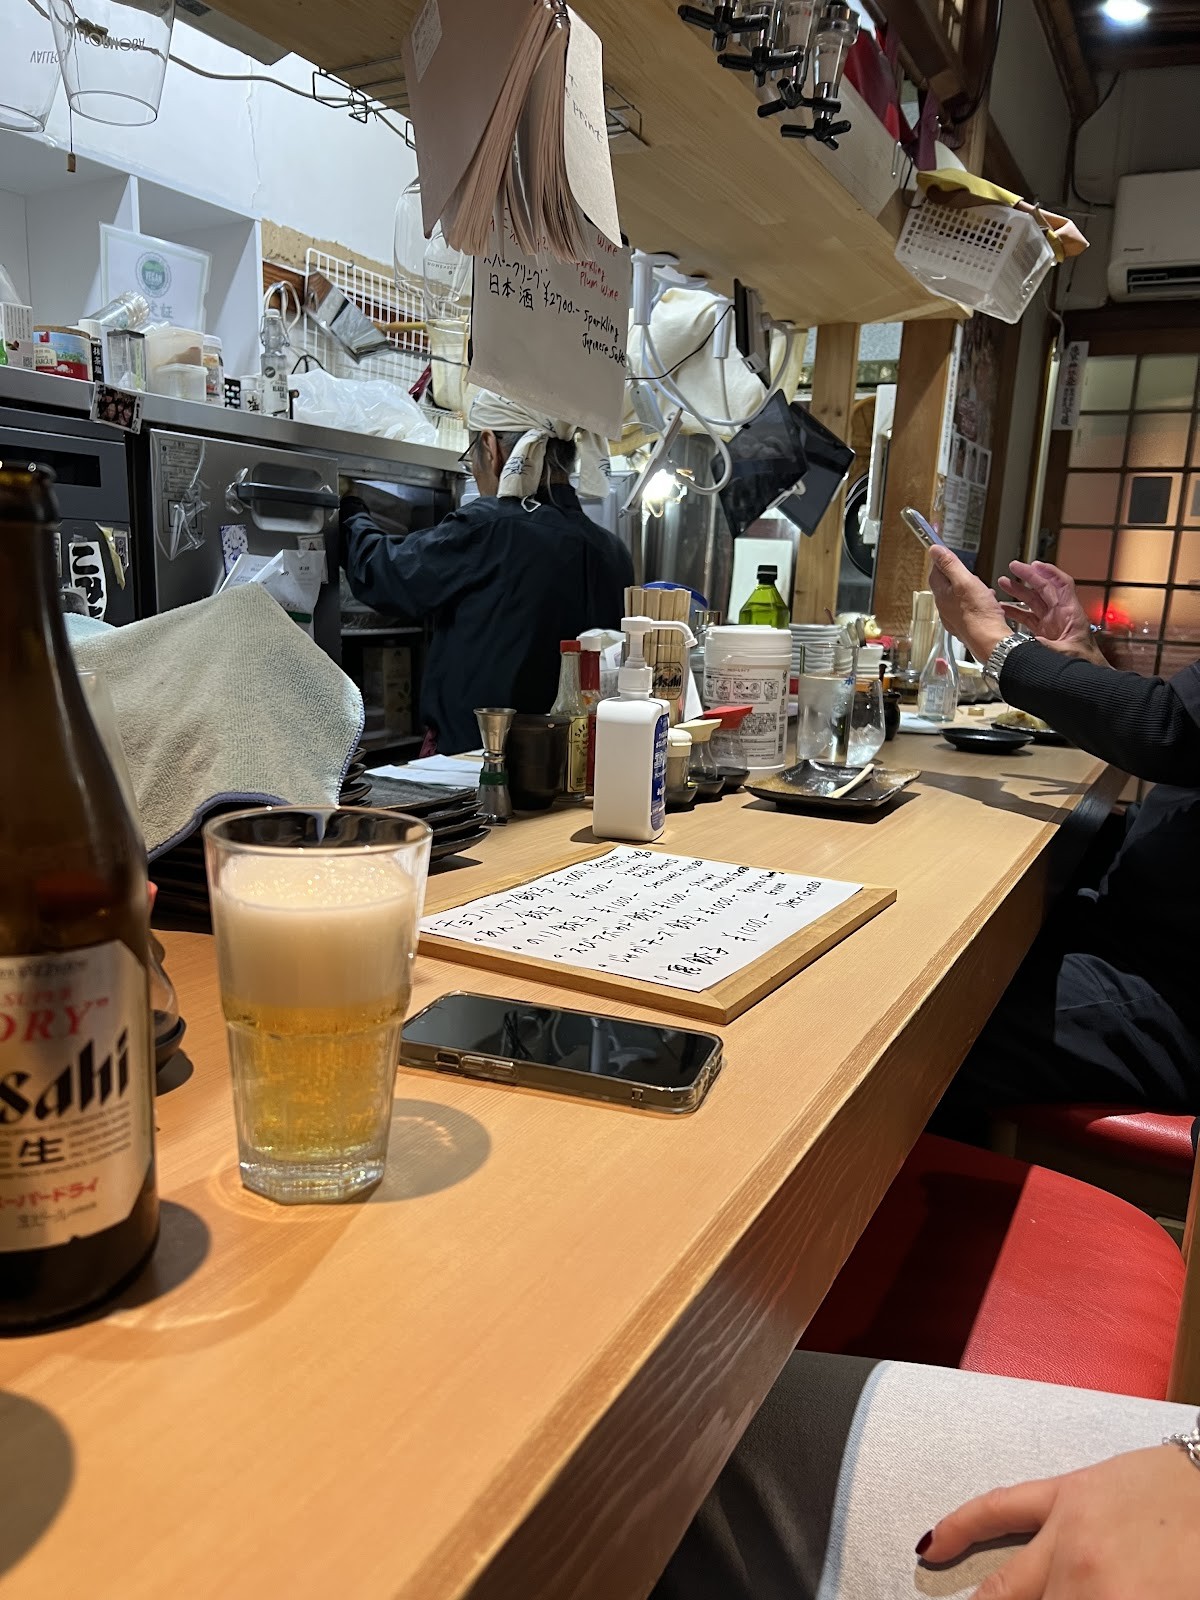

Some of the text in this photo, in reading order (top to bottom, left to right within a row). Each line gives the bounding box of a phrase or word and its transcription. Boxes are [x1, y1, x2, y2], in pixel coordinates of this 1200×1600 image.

[489, 272, 534, 311] 日本酒
[579, 271, 598, 288] Plum
[583, 309, 620, 343] Sparkling
[653, 674, 682, 688] Asahi
[527, 915, 598, 945] のり餃子
[0, 1027, 130, 1124] sahi
